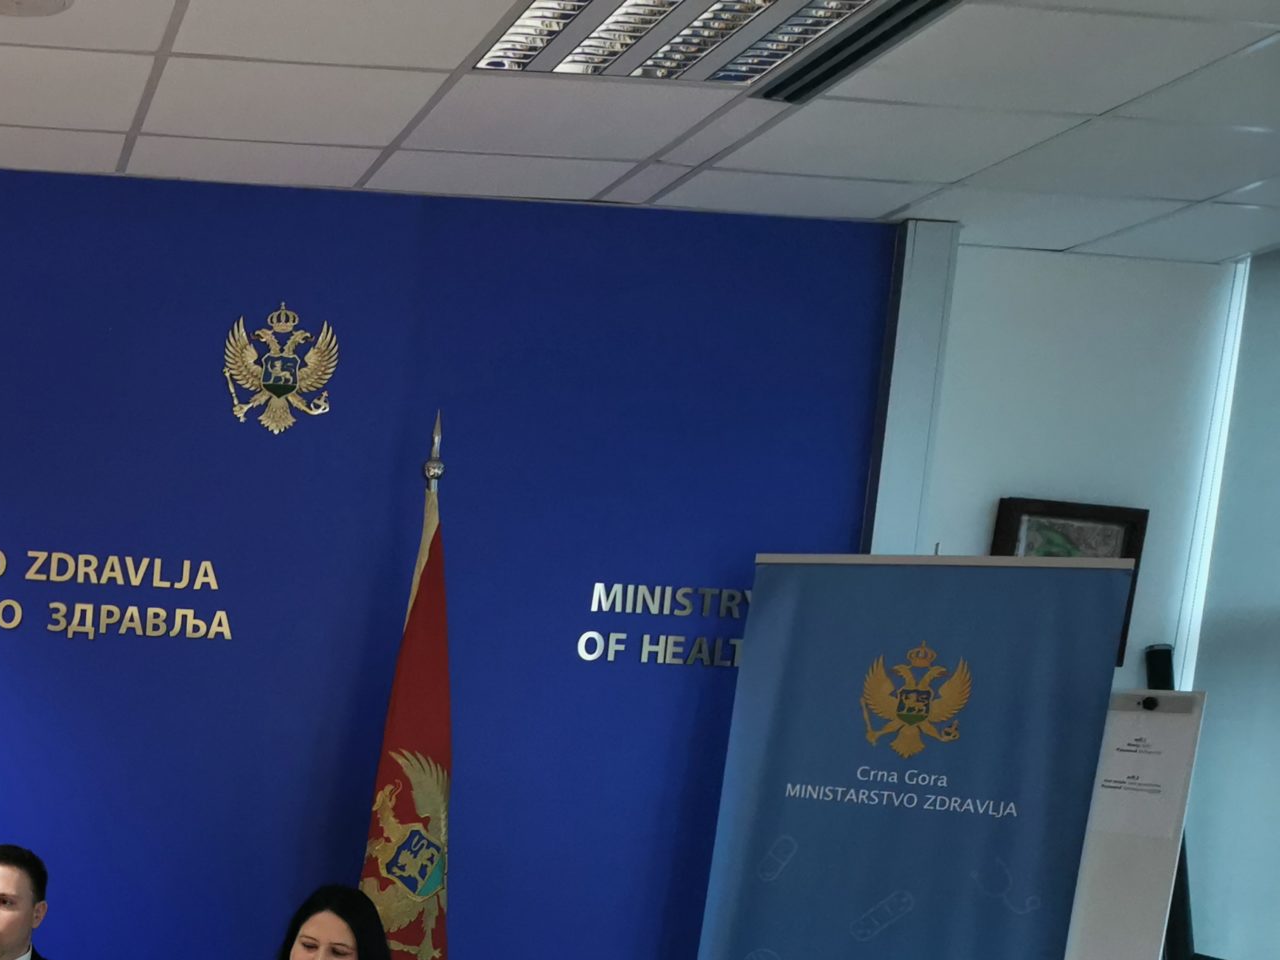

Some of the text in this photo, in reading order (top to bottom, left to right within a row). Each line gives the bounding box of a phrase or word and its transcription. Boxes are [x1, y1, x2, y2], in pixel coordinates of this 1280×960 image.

[25, 550, 220, 591] ZDRAVLJA
[47, 602, 233, 640] ЗДРАВЉА
[577, 630, 627, 662] OF
[856, 766, 948, 787] Crna Gora
[785, 783, 1018, 818] MINISTARSTVO ZDRAVLJA
